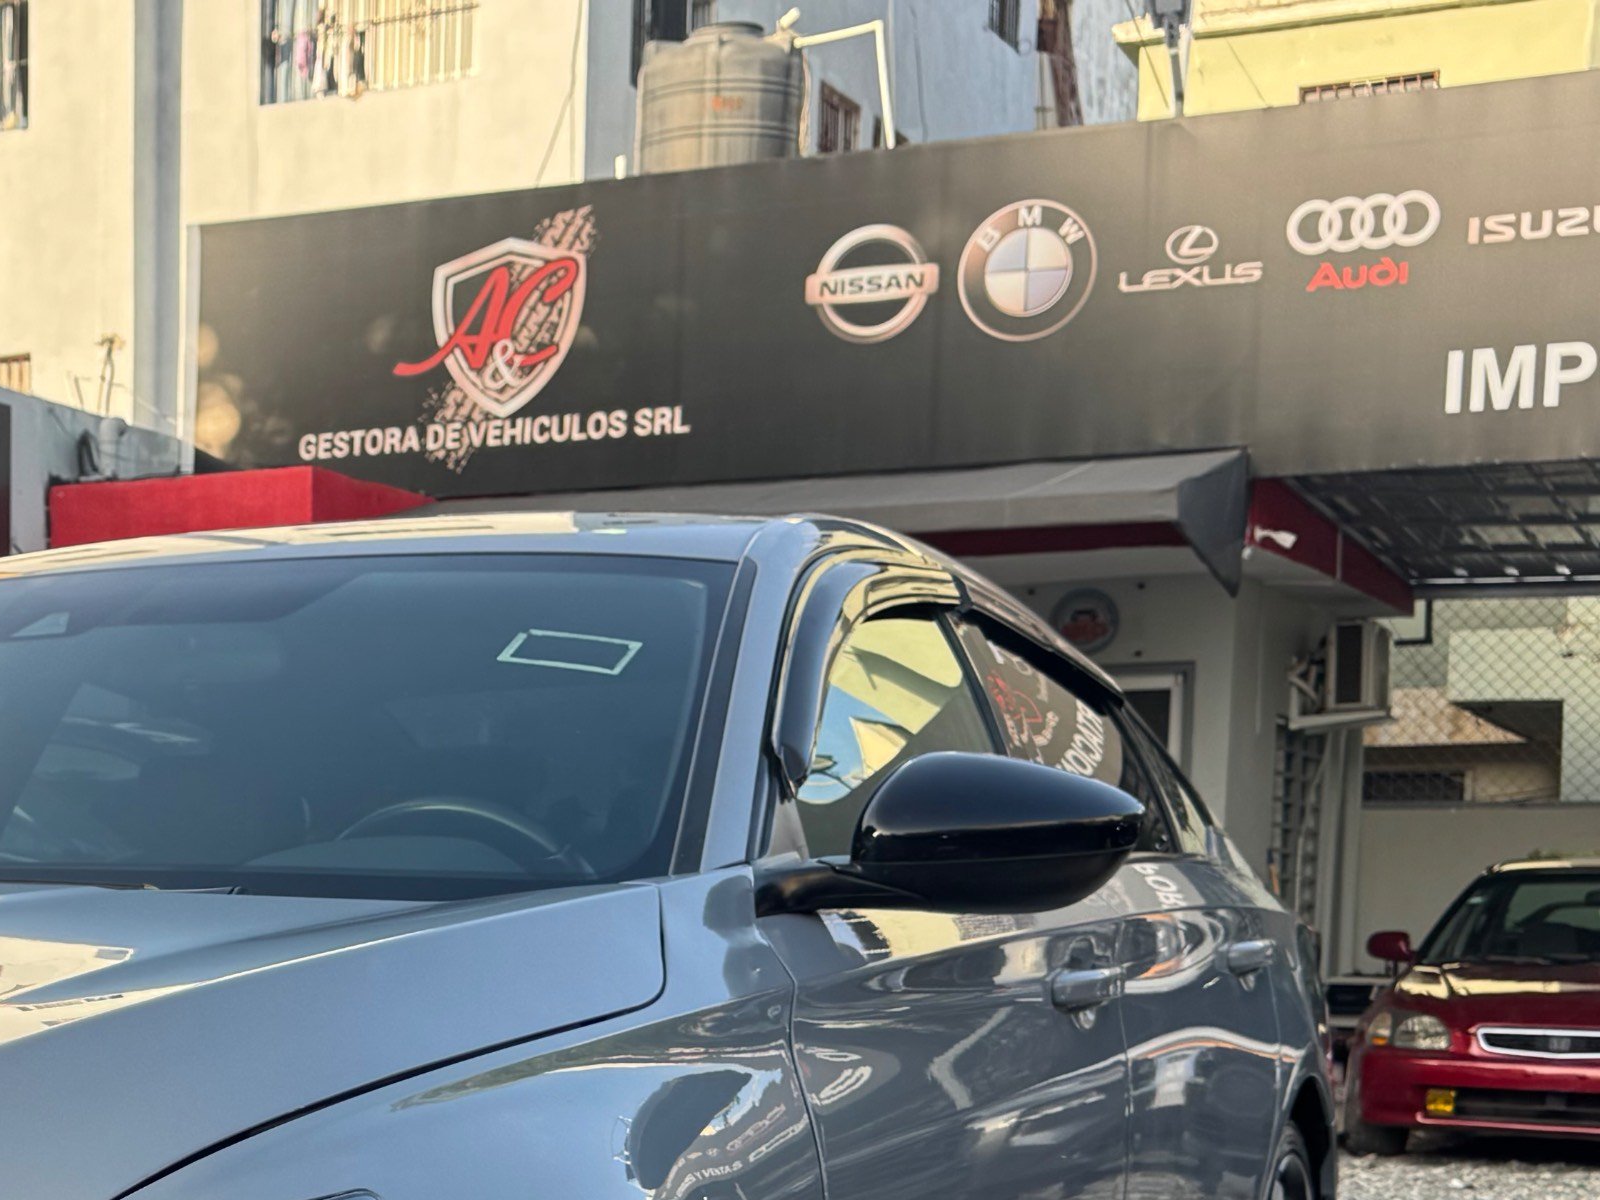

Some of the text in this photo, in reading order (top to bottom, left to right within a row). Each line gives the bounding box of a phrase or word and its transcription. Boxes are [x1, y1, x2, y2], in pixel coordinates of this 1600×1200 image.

[975, 205, 1085, 252] BMW
[1466, 204, 1600, 245] ISUZ
[818, 271, 926, 297] NISSAN
[1117, 261, 1264, 293] LEXUS
[1305, 256, 1409, 292] Audi
[299, 405, 692, 461] GESTORA DE VEHICULOS SRL
